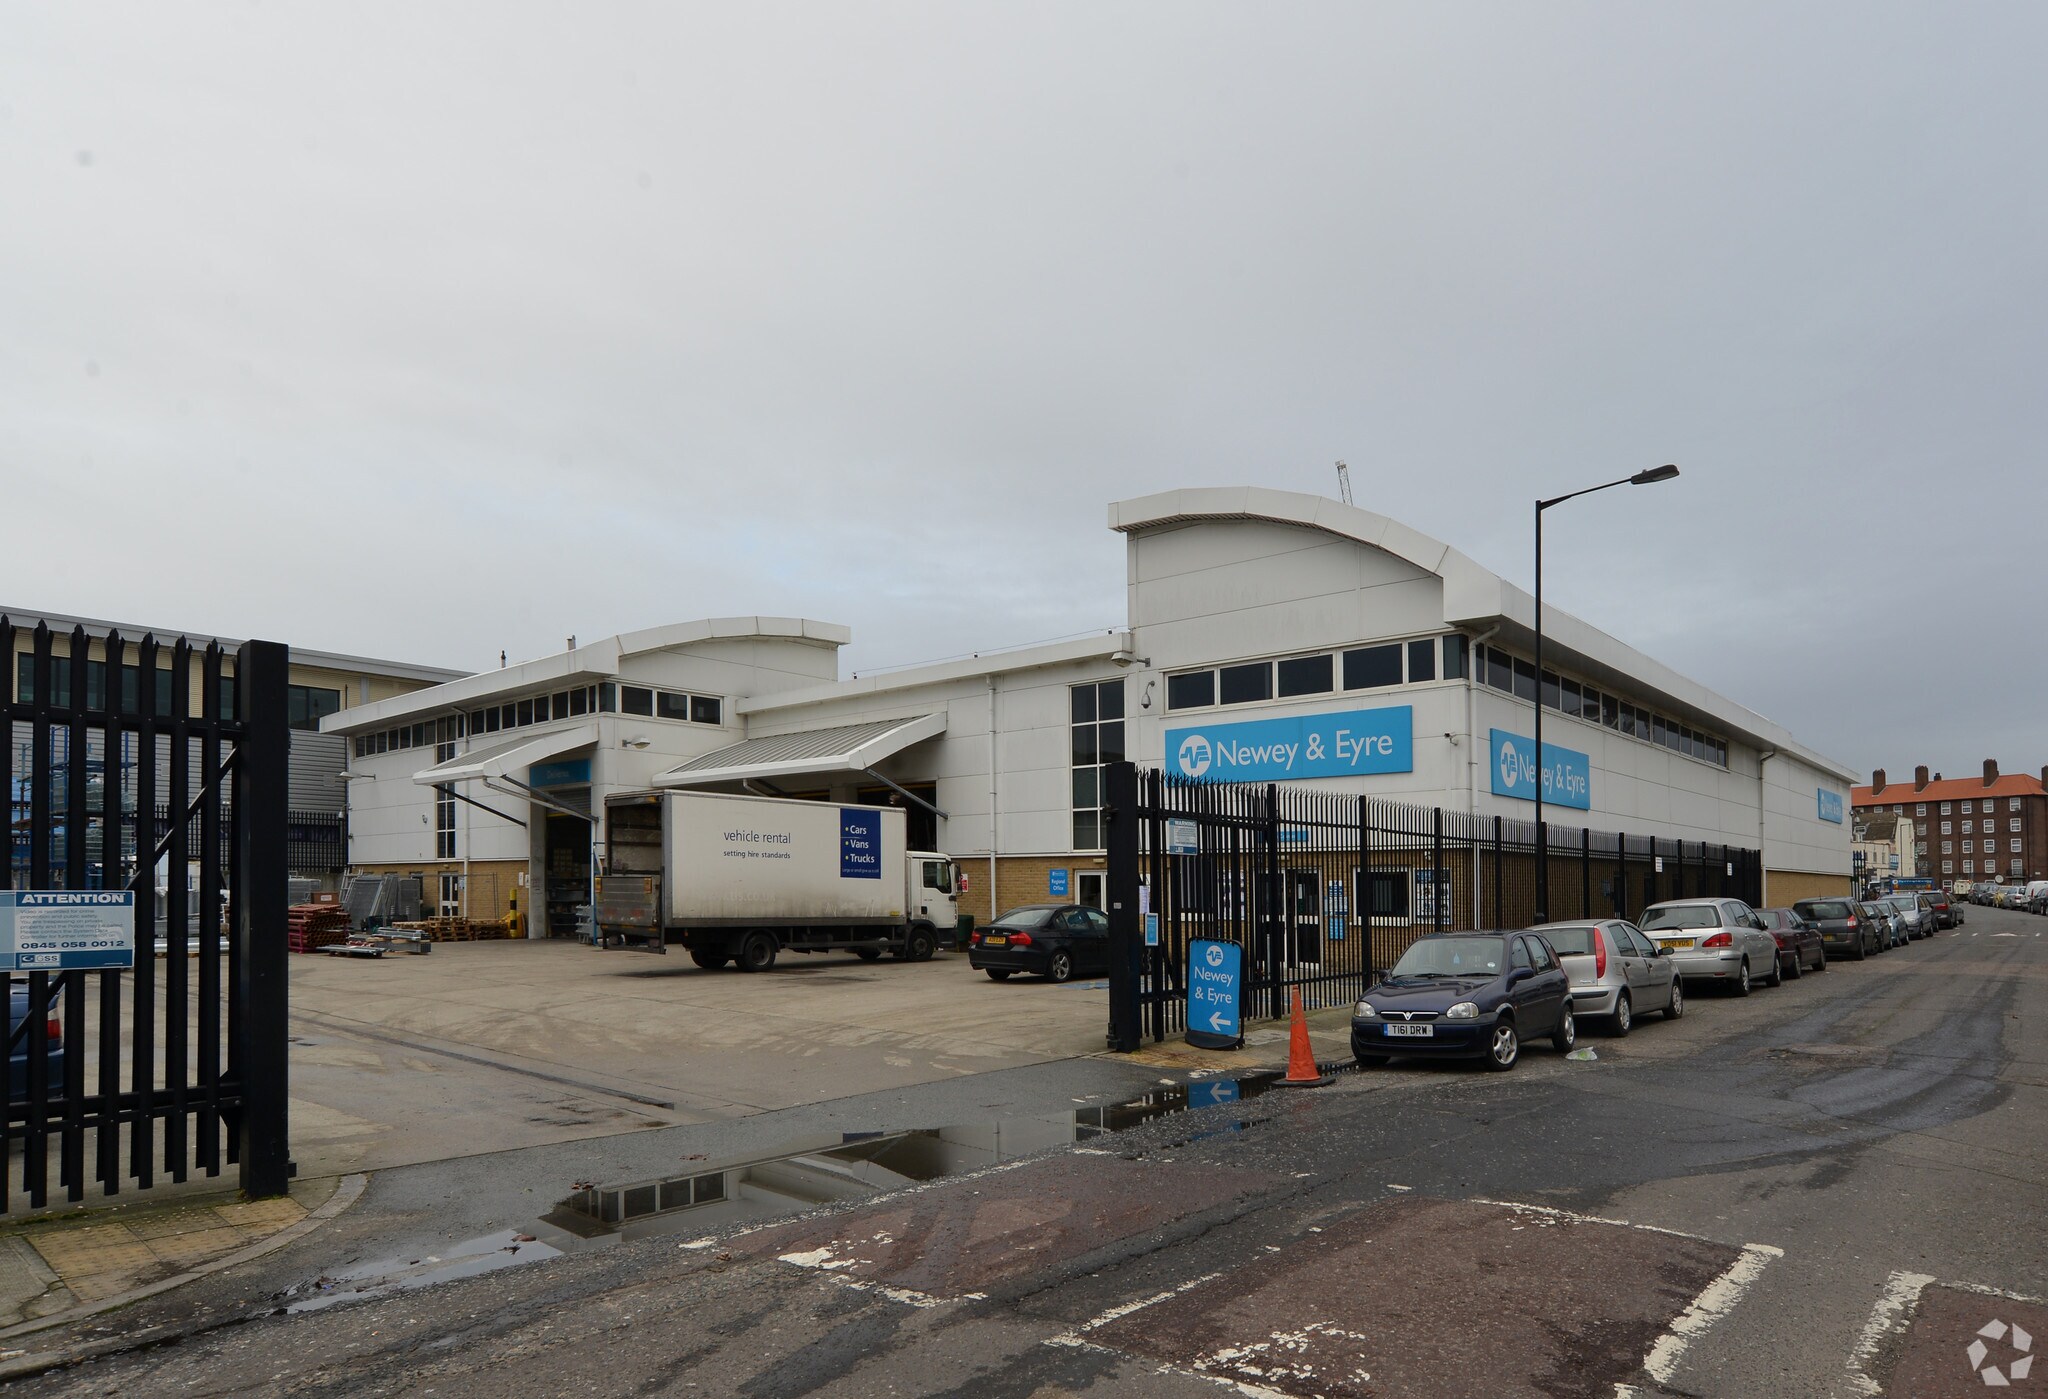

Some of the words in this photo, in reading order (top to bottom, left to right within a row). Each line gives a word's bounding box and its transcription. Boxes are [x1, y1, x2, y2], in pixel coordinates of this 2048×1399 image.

[1216, 740, 1299, 771] Newey
[1305, 733, 1325, 761] &
[1336, 729, 1393, 766] Eyre
[1556, 763, 1564, 790] &
[1566, 765, 1585, 799] Eyre
[850, 825, 867, 834] Cars
[723, 830, 760, 842] vehicle
[762, 832, 791, 844] rental
[850, 839, 869, 849] Vans
[723, 850, 746, 859] setting
[747, 850, 760, 858] hire
[761, 851, 791, 859] standards
[850, 854, 875, 863] Trucks
[21, 894, 124, 904] ATTENTION
[1194, 965, 1234, 987] Newey
[1195, 986, 1204, 999] &
[1207, 987, 1232, 1006] Eyre
[1392, 1025, 1408, 1035] T161
[1410, 1025, 1428, 1035] DRW
